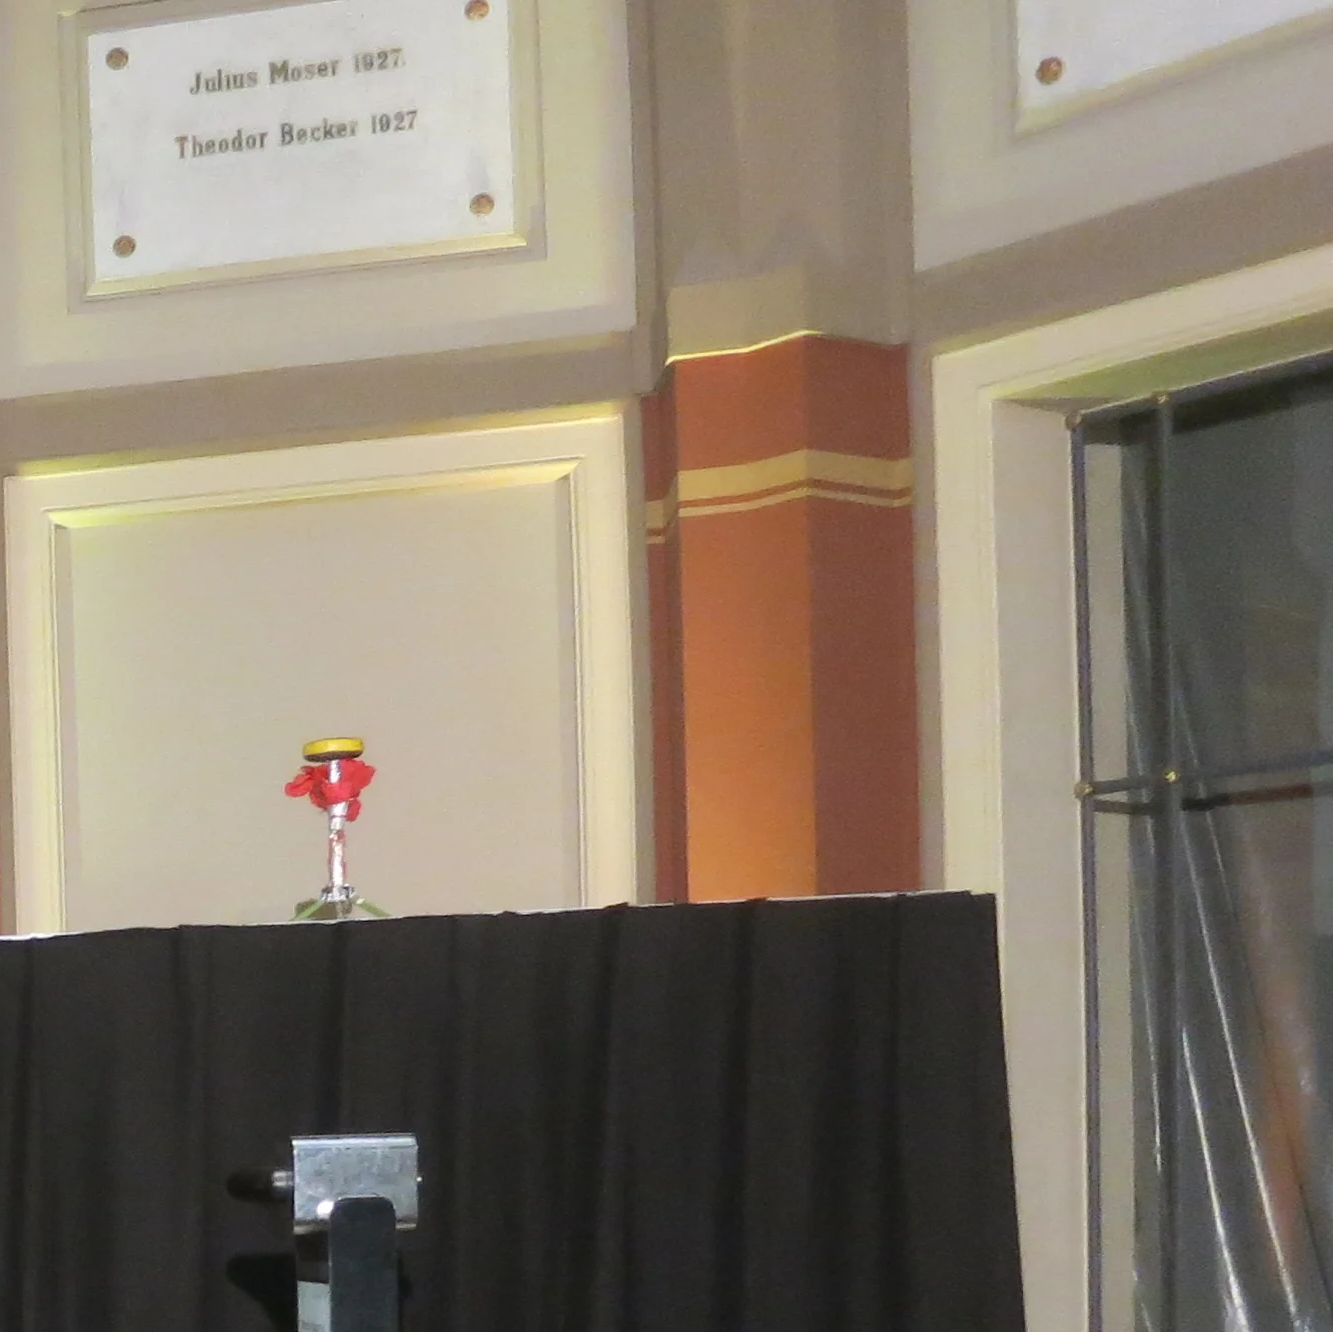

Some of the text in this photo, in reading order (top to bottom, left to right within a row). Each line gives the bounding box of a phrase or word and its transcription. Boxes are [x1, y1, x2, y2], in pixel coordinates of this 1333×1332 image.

[190, 68, 258, 95] Julius
[268, 58, 341, 85] Moser
[174, 128, 268, 160] Theodor
[280, 118, 358, 147] Becker
